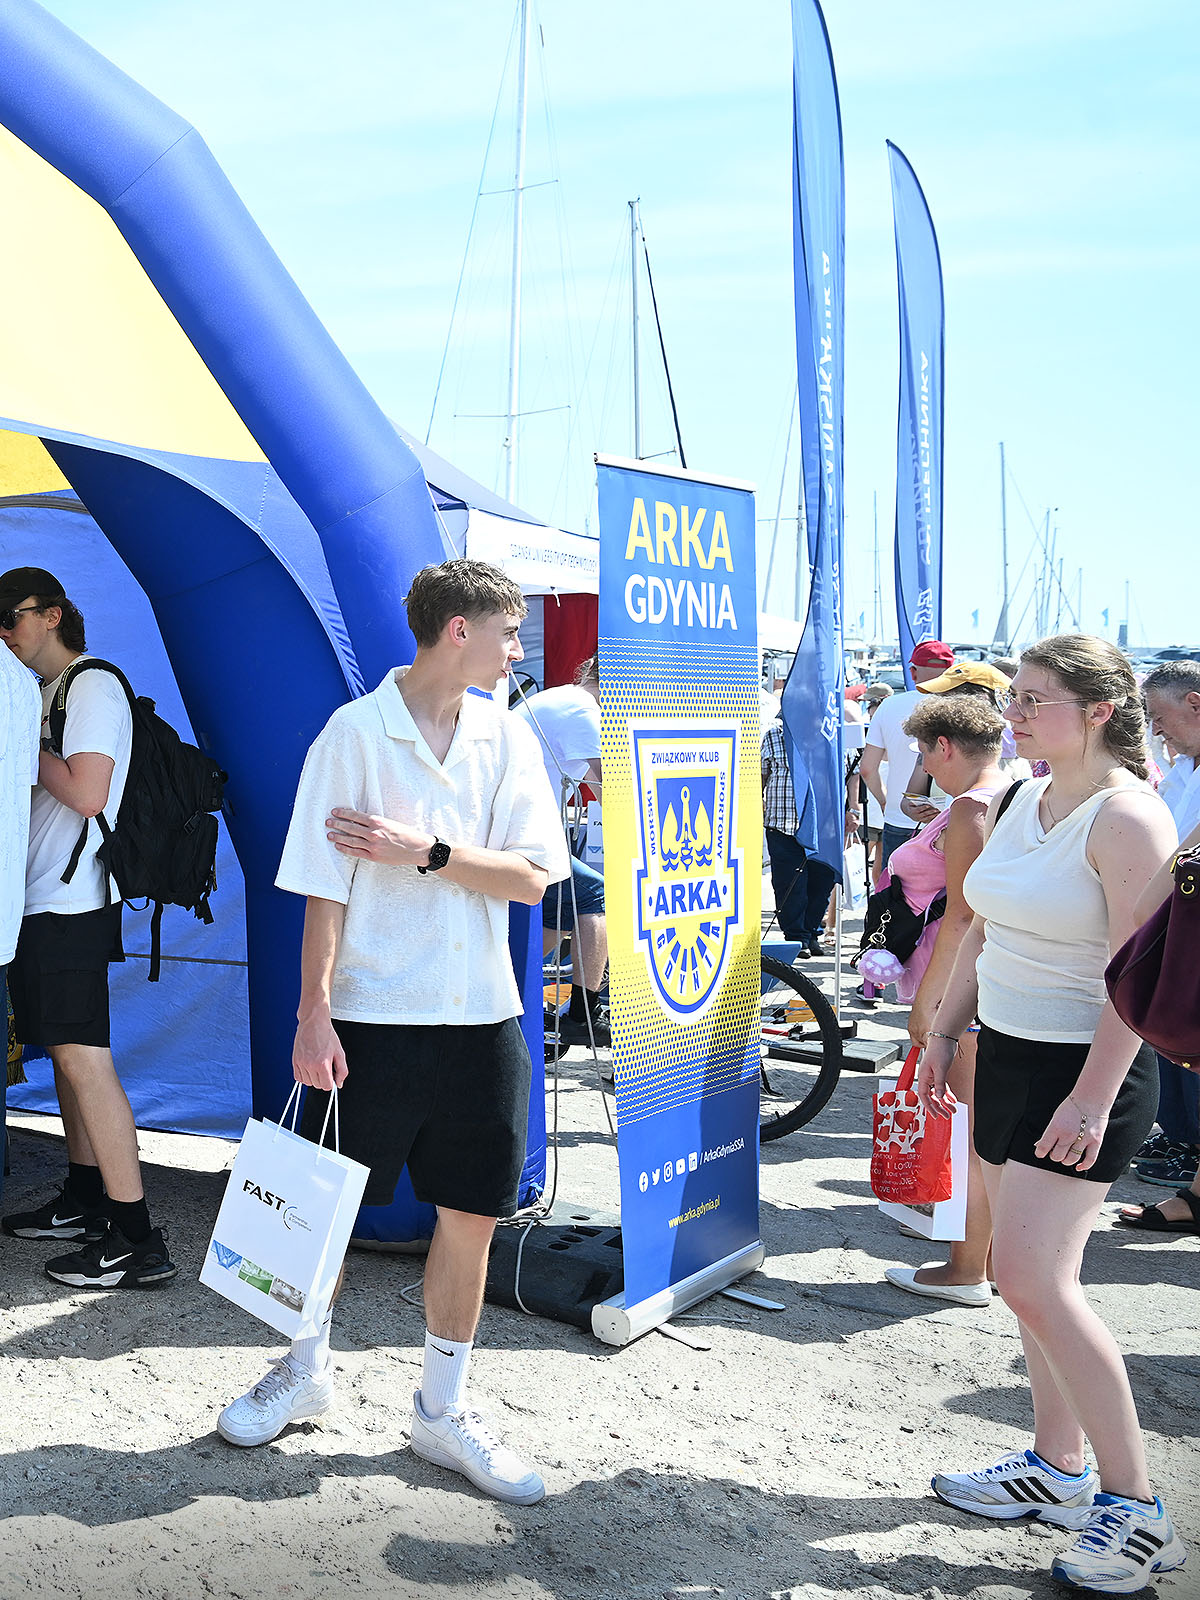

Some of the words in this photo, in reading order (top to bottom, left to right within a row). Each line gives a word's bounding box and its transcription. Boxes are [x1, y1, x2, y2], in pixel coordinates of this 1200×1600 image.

[625, 497, 734, 573] ARKA
[624, 573, 738, 631] GDYNIA
[699, 751, 720, 763] KLUB
[647, 790, 656, 856] MORSKI
[717, 771, 726, 859] SPORTOWY
[654, 880, 722, 917] ARKA
[656, 925, 721, 995] GDYNIA
[242, 1179, 286, 1211] FAST
[668, 1195, 721, 1229] www.arka.gdynia.pl
